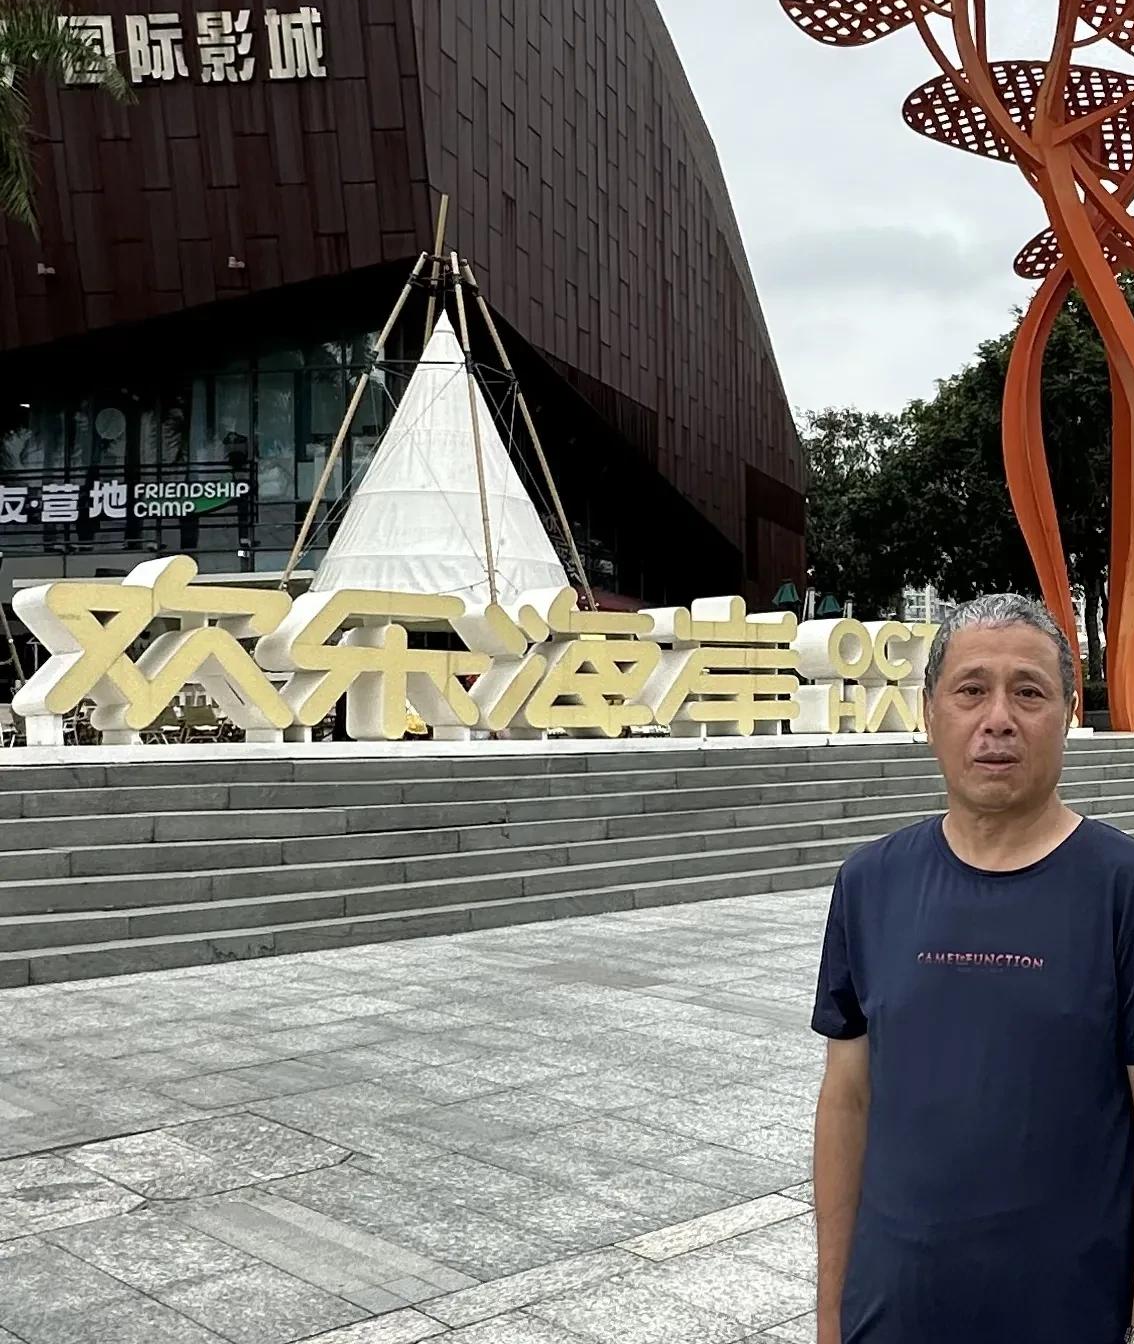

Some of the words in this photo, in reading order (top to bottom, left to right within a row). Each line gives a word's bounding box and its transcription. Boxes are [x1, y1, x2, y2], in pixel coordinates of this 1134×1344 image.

[0, 6, 327, 85] 国际影城
[133, 482, 250, 500] FRIENDSHIP
[133, 501, 195, 518] CAMP
[12, 554, 801, 740] 欢乐海岸
[827, 684, 928, 734] HA
